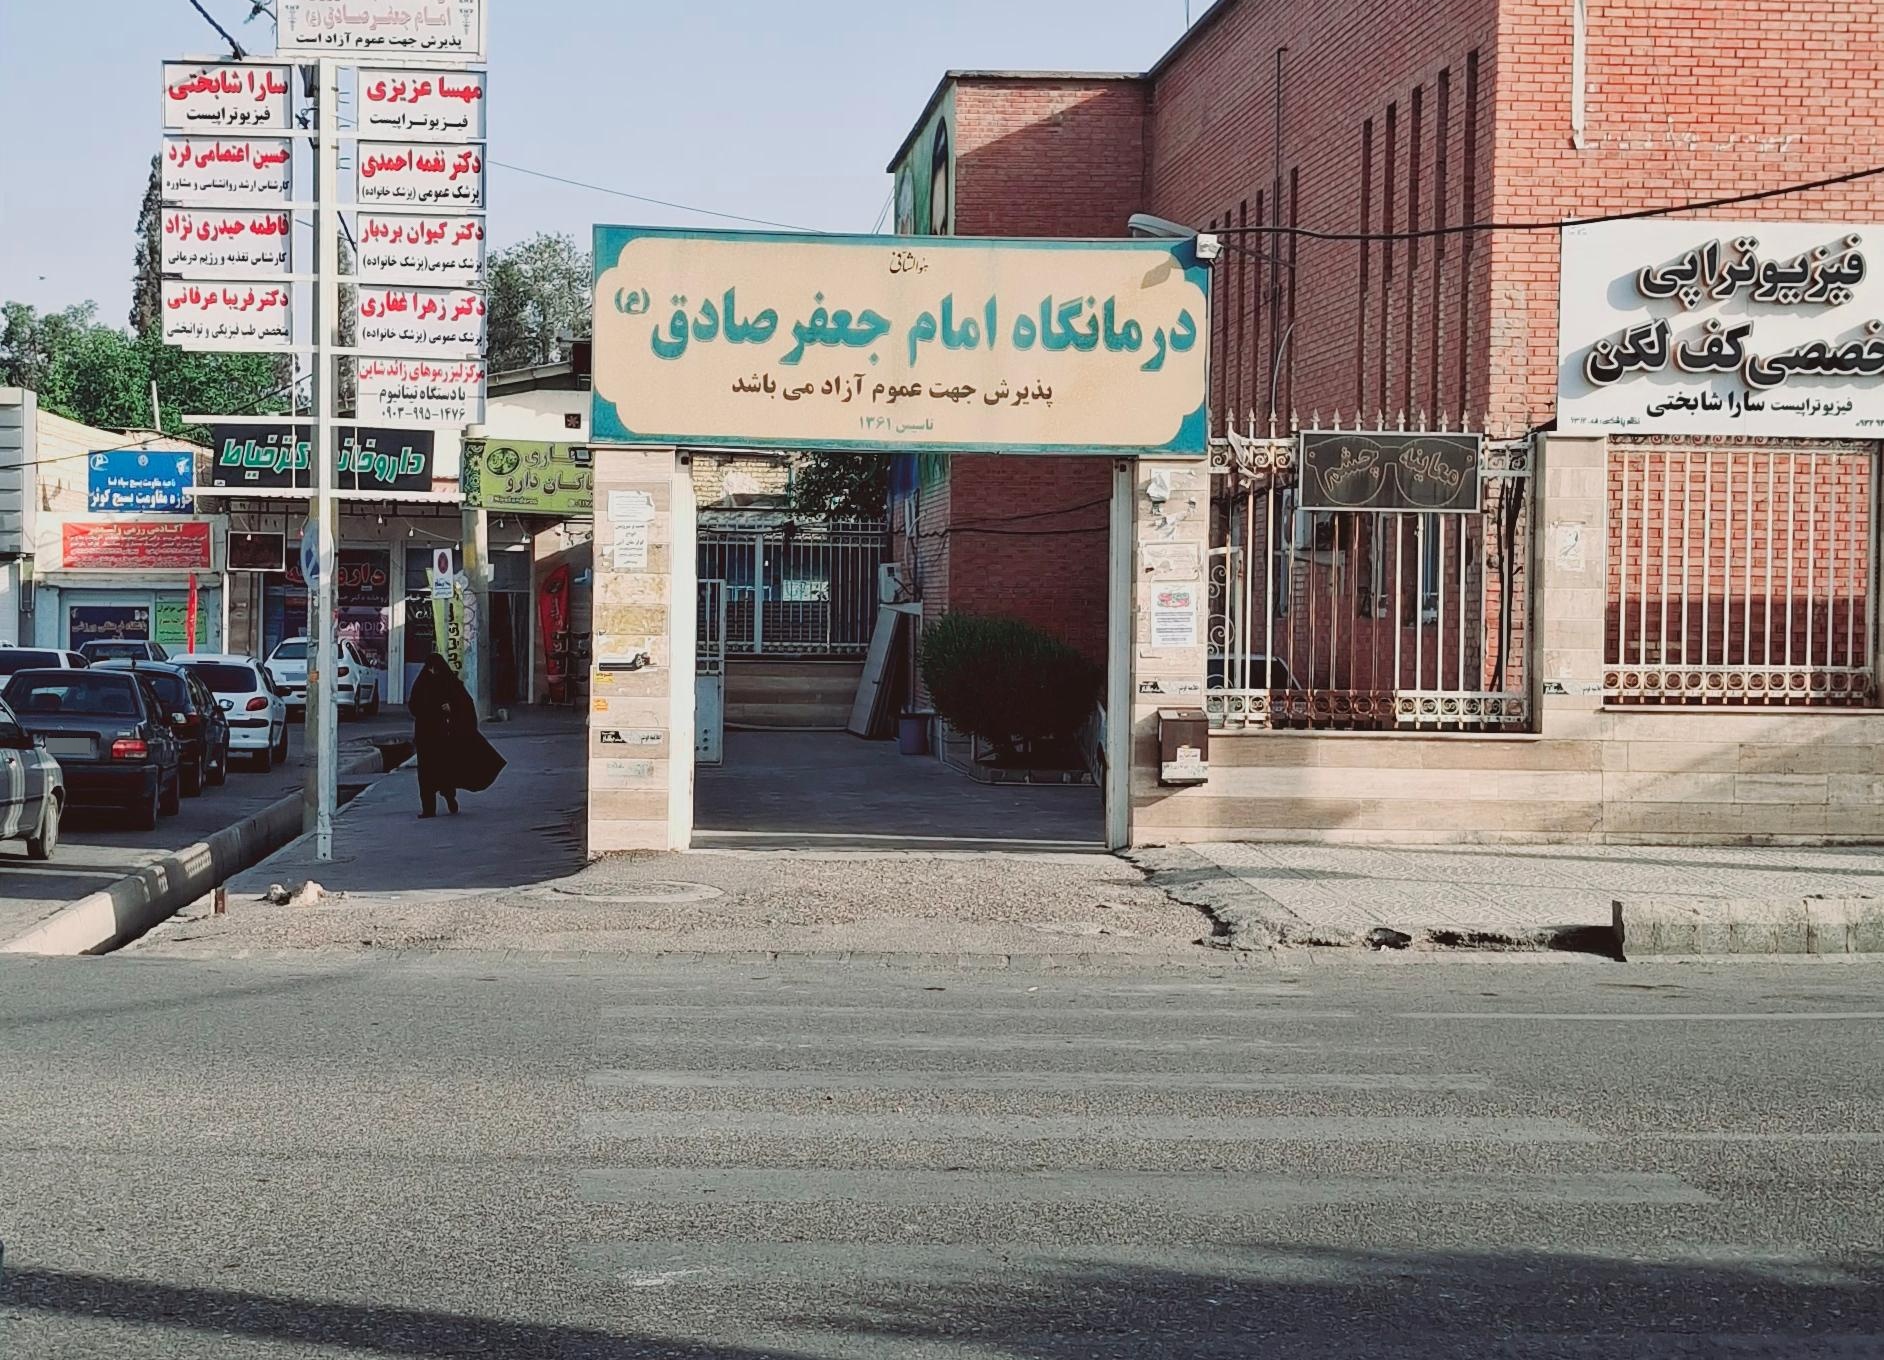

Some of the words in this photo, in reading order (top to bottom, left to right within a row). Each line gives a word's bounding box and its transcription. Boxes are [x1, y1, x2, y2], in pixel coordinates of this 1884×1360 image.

[323, 4, 370, 29] صادق
[369, 6, 411, 31] جعفر
[415, 6, 452, 31] امام
[296, 33, 322, 43] است
[325, 31, 351, 48] آزاد
[355, 37, 385, 48] عموم
[388, 36, 417, 47] جهت
[421, 35, 462, 50] پذیرش
[168, 69, 243, 100] شابختی
[246, 70, 288, 102] سارا
[366, 78, 432, 103] عزیزی
[438, 75, 483, 104] مهسا
[186, 106, 271, 125] فیزیوتراپیست
[369, 113, 468, 131] فیزیوتراپیست
[168, 138, 192, 168] فرد
[194, 141, 250, 169] اعتصامی
[253, 148, 290, 169] حسین
[361, 148, 413, 178] احمدی
[416, 149, 446, 172] نغمه
[449, 150, 481, 181] دکتر
[193, 183, 198, 191] و
[238, 180, 256, 191] ارشد
[258, 179, 290, 192] کارشناس
[418, 187, 449, 202] عمومی
[452, 185, 479, 204] پزشک
[165, 213, 193, 241] نژاد
[196, 219, 246, 241] حیدری
[249, 213, 289, 236] فاطمه
[361, 219, 403, 244] بردبار
[407, 220, 448, 245] کیوان
[451, 221, 484, 246] دکتر
[168, 251, 197, 265] درمانی
[226, 251, 249, 265] تغذیه
[250, 251, 287, 266] کارشناس
[458, 258, 482, 273] پزشک
[1640, 233, 1865, 309] فیزیوتراپی
[167, 286, 218, 311] عرفانی
[222, 287, 255, 311] فریبا
[256, 289, 289, 311] دکتر
[361, 290, 408, 317] غفاری
[412, 292, 447, 321] زهرا
[451, 296, 486, 321] دکتر
[614, 286, 650, 314] (ع)
[650, 286, 779, 361] صادق
[779, 290, 892, 366] جعفر
[908, 292, 998, 368] امام
[1012, 293, 1198, 372] درمانگاه
[429, 334, 457, 346] عمومی
[458, 331, 483, 346] پزشک
[1678, 319, 1753, 372] کف
[1586, 318, 1672, 385] لگن
[1746, 320, 1884, 388] خصصی
[379, 384, 418, 404] تیتانیوم
[420, 384, 457, 400] دستگاه
[458, 385, 466, 405] با
[731, 373, 777, 399] باشد
[783, 384, 814, 401] می
[821, 373, 866, 403] آزاد
[872, 381, 922, 405] عموم
[929, 381, 976, 405] جهت
[983, 379, 1053, 407] پذیرش
[1647, 390, 1722, 417] شابختی
[1728, 390, 1765, 418] سارا
[1771, 397, 1853, 416] فیزیوتراپیست
[896, 417, 934, 434] تاسیس
[219, 434, 278, 479] خیاط
[272, 434, 312, 474] کتر
[337, 437, 426, 484] داروخان
[1324, 446, 1380, 491] چشم
[1399, 447, 1459, 487] معاینه
[505, 469, 539, 494] دارو
